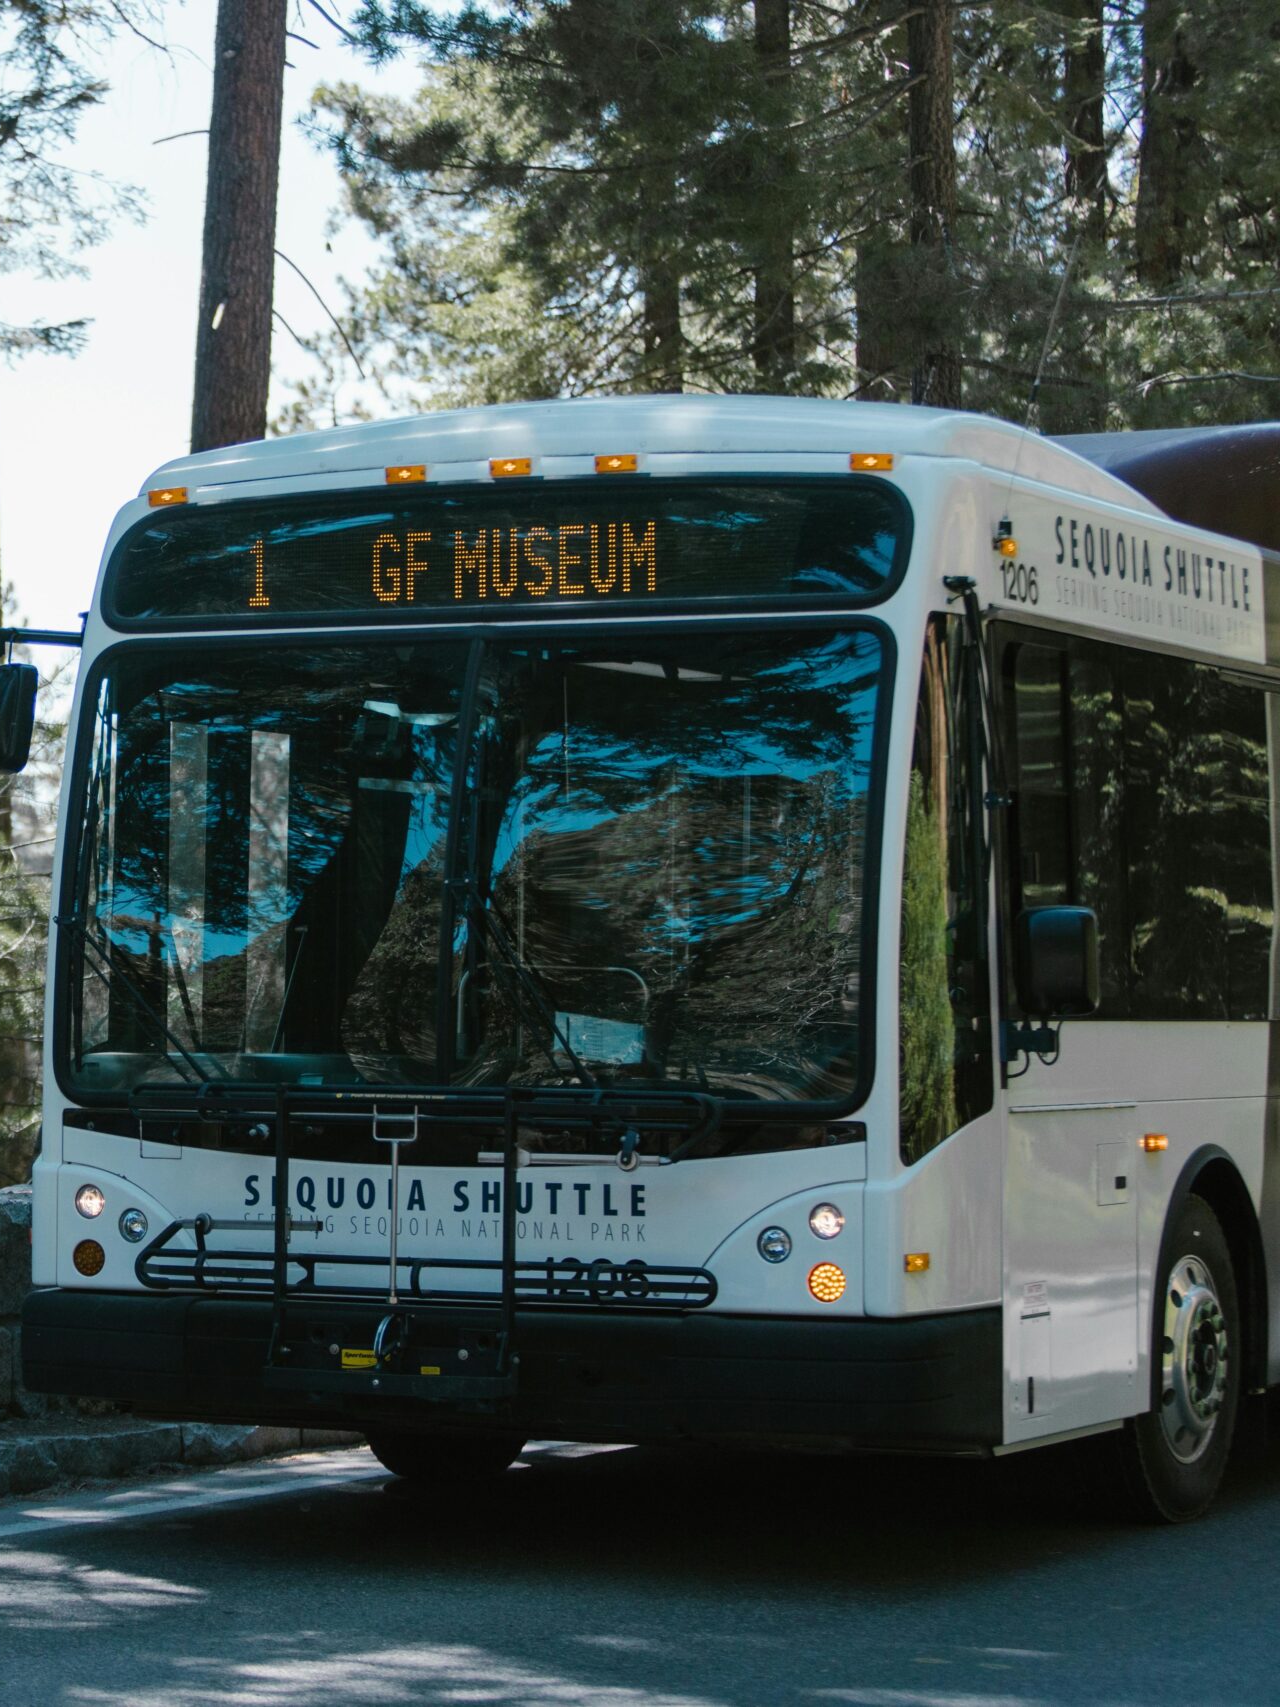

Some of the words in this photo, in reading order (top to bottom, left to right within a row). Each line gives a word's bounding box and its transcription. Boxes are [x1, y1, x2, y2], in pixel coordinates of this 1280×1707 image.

[249, 540, 270, 607] 1
[372, 532, 432, 602] GF
[454, 521, 656, 600] MUSEUM
[1000, 559, 1039, 606] 1206
[1055, 515, 1153, 588] SEQUOIA
[1163, 545, 1250, 613] SHUTTLE
[453, 1180, 646, 1217] SHUTTLE
[461, 1219, 574, 1241] NATONAL
[591, 1222, 647, 1242] PARK
